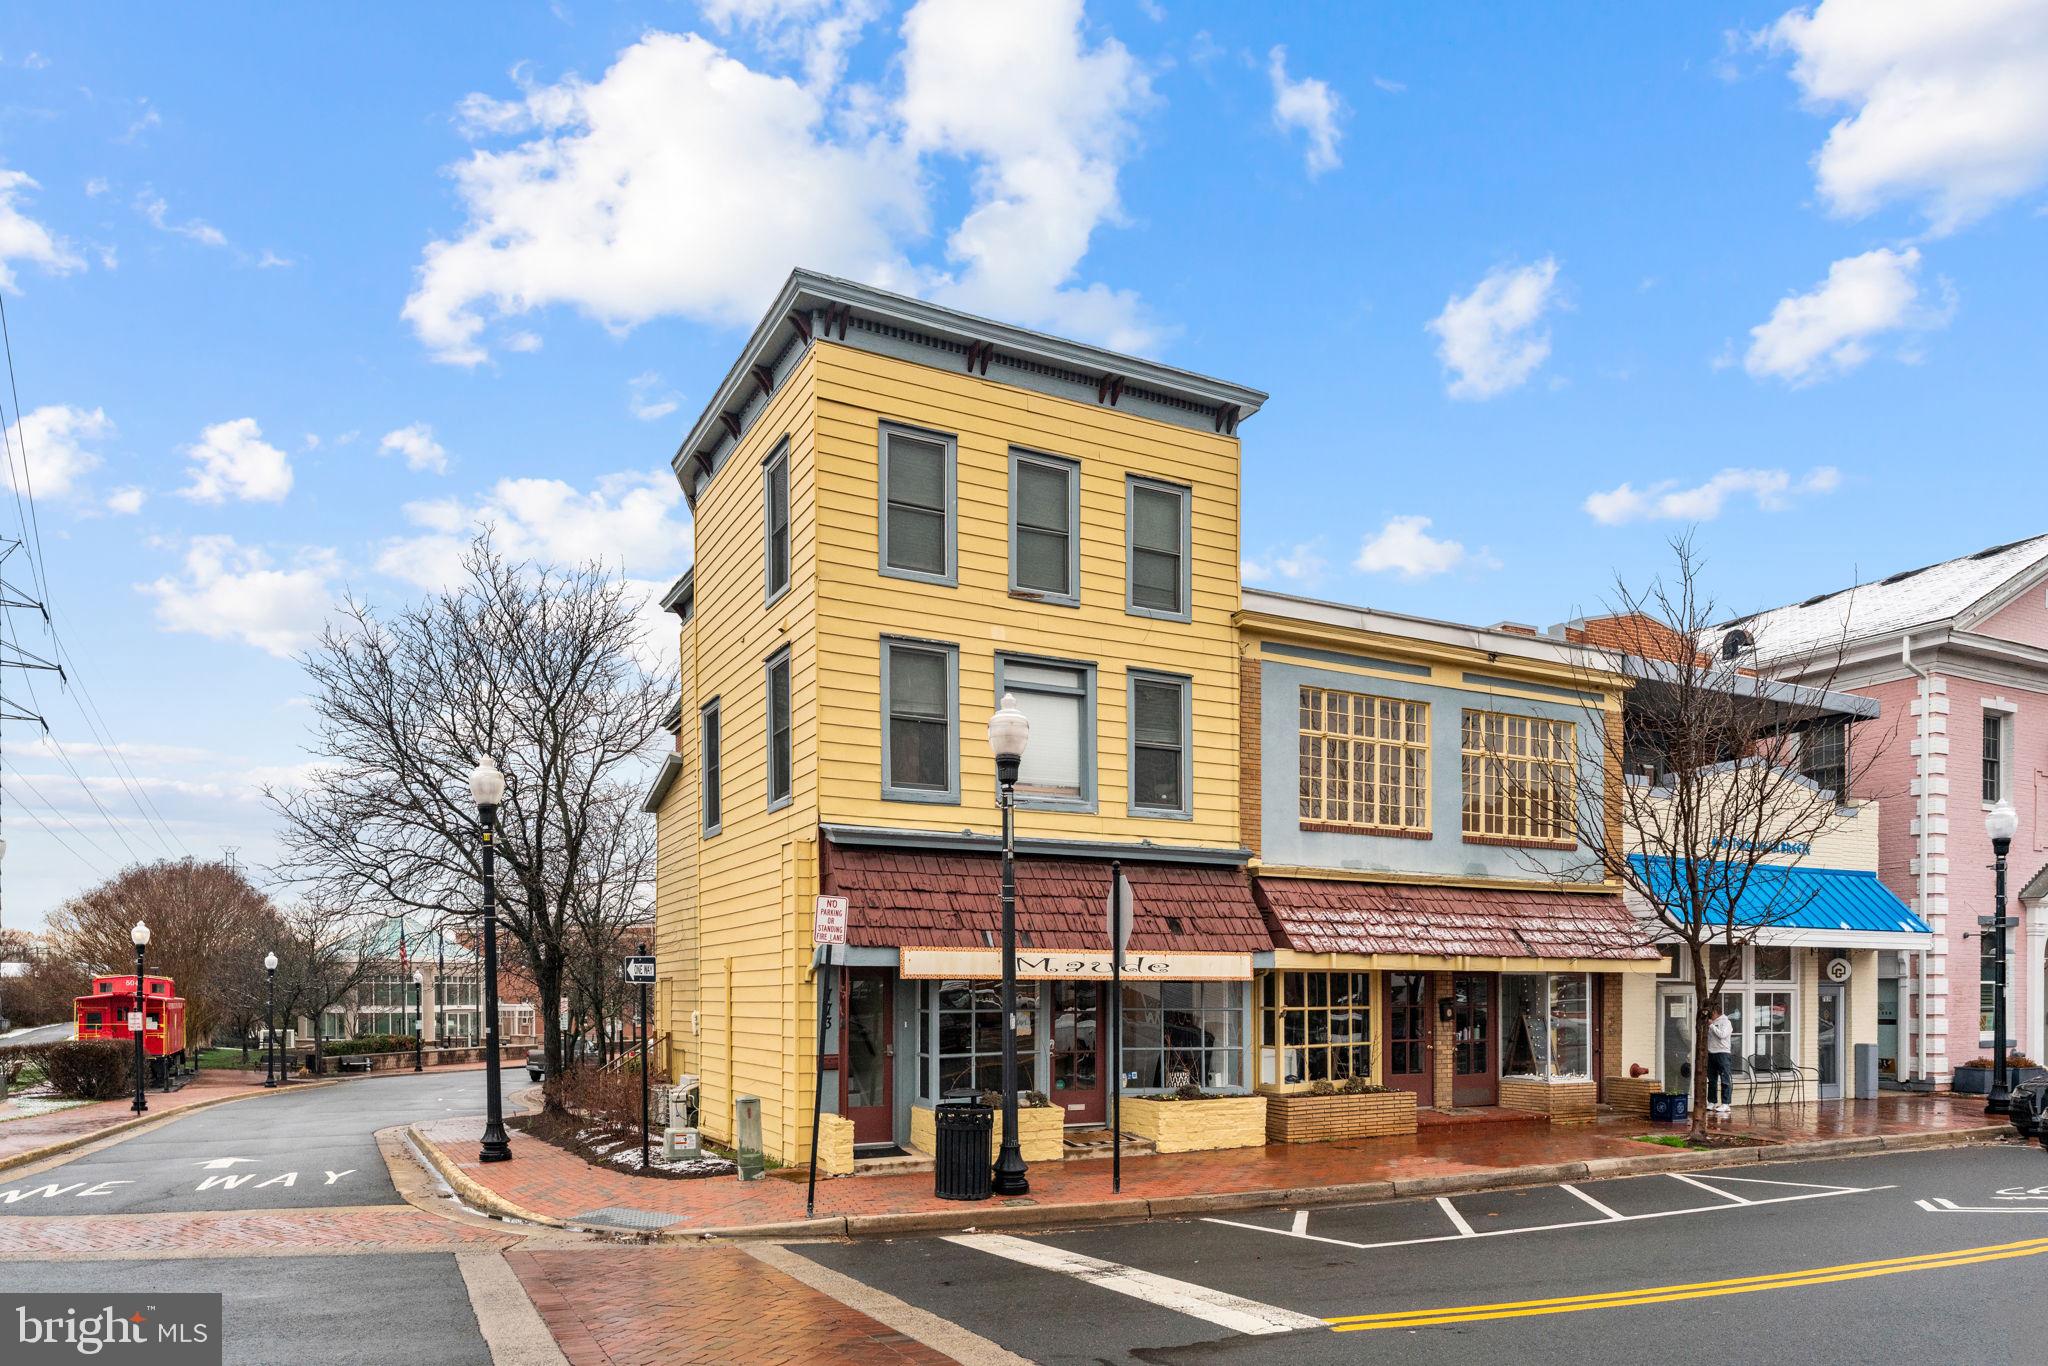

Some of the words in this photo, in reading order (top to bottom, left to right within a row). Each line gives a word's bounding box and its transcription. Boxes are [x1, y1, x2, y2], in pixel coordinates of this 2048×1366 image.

[826, 900, 838, 909] NO
[820, 908, 843, 917] PARKING
[827, 917, 835, 925] OR
[818, 924, 843, 934] STANDING
[816, 932, 828, 941] FIRE
[829, 934, 843, 942] LANE
[634, 964, 643, 975] ONE
[643, 964, 653, 975] WAY
[1016, 957, 1171, 973] Maude
[0, 1180, 136, 1203] NE
[194, 1170, 357, 1192] WAY
